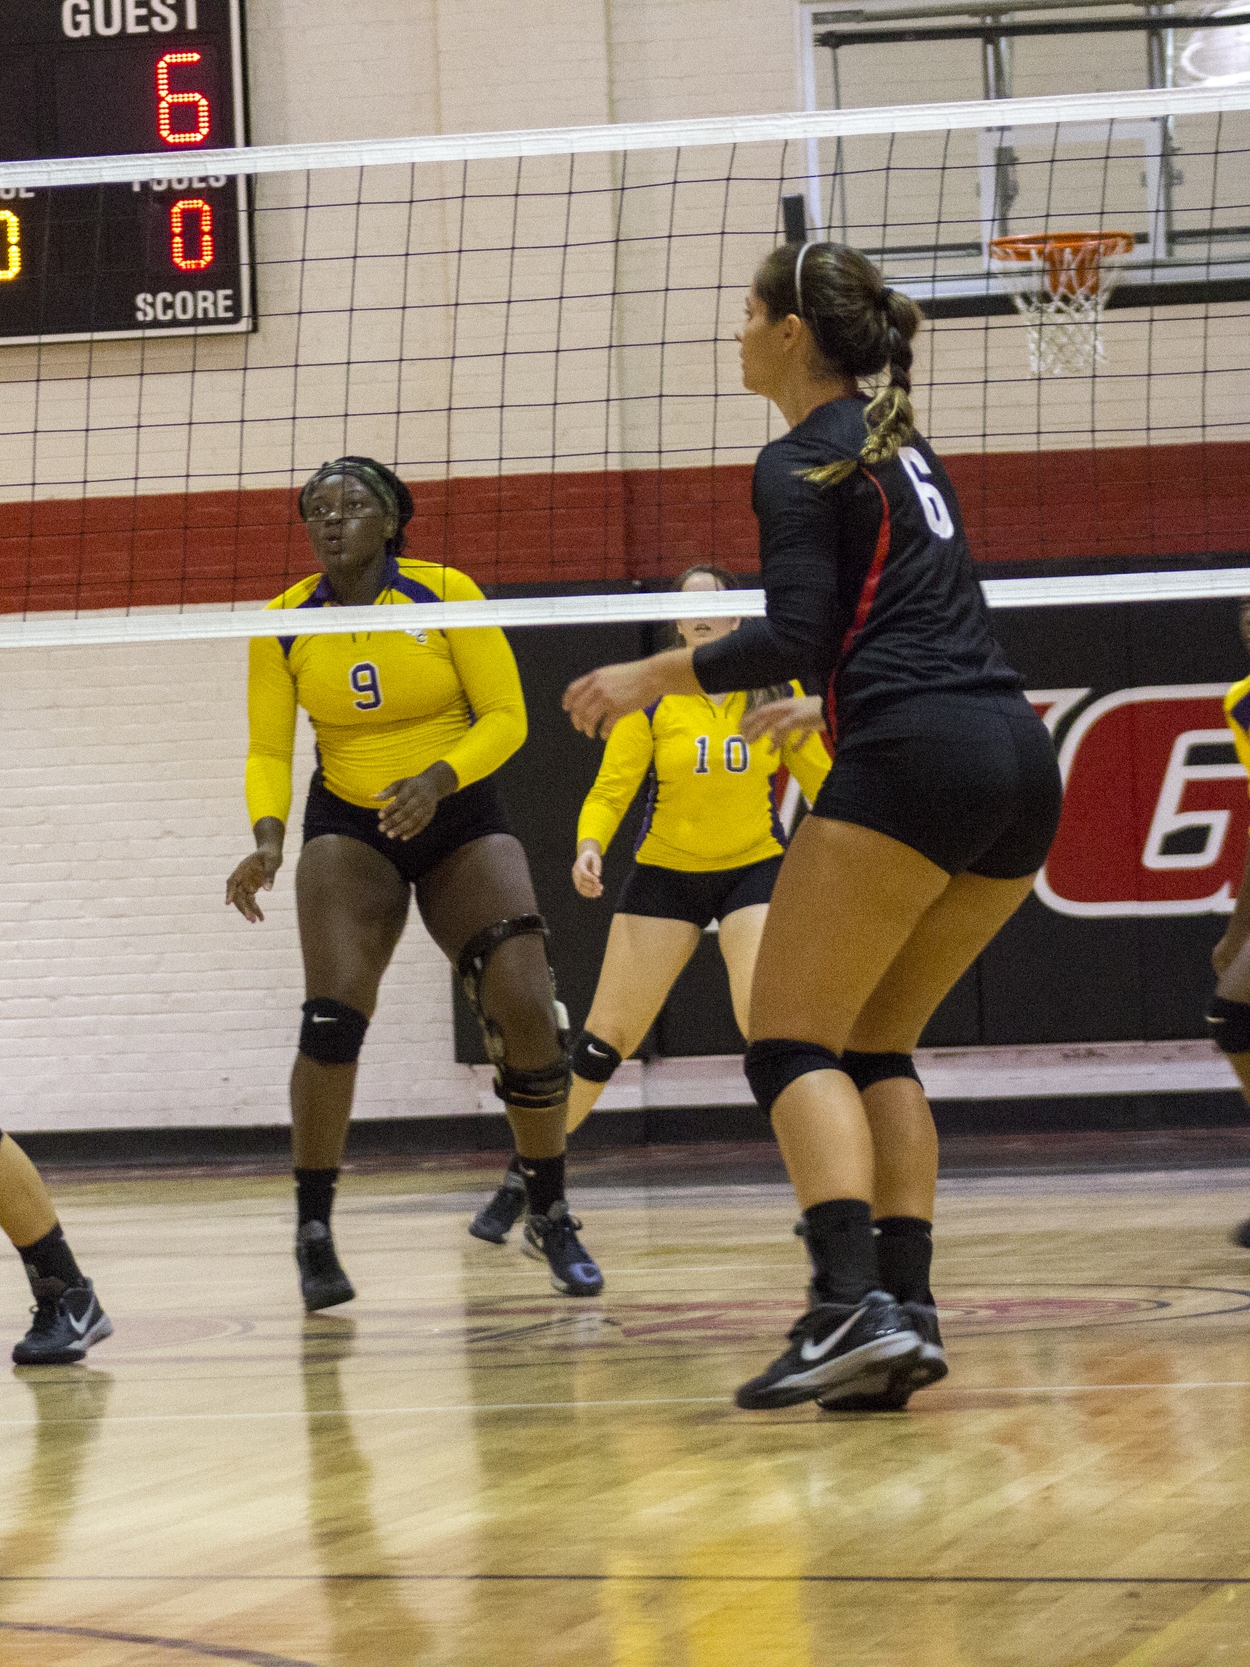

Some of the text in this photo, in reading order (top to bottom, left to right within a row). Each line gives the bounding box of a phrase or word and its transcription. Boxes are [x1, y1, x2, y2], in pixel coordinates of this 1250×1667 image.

[61, 0, 198, 38] GUEST
[157, 52, 209, 144] 6
[170, 198, 213, 271] 0
[135, 289, 234, 322] SCORE
[897, 446, 955, 539] 6
[348, 661, 383, 712] 9
[693, 734, 750, 774] 10
